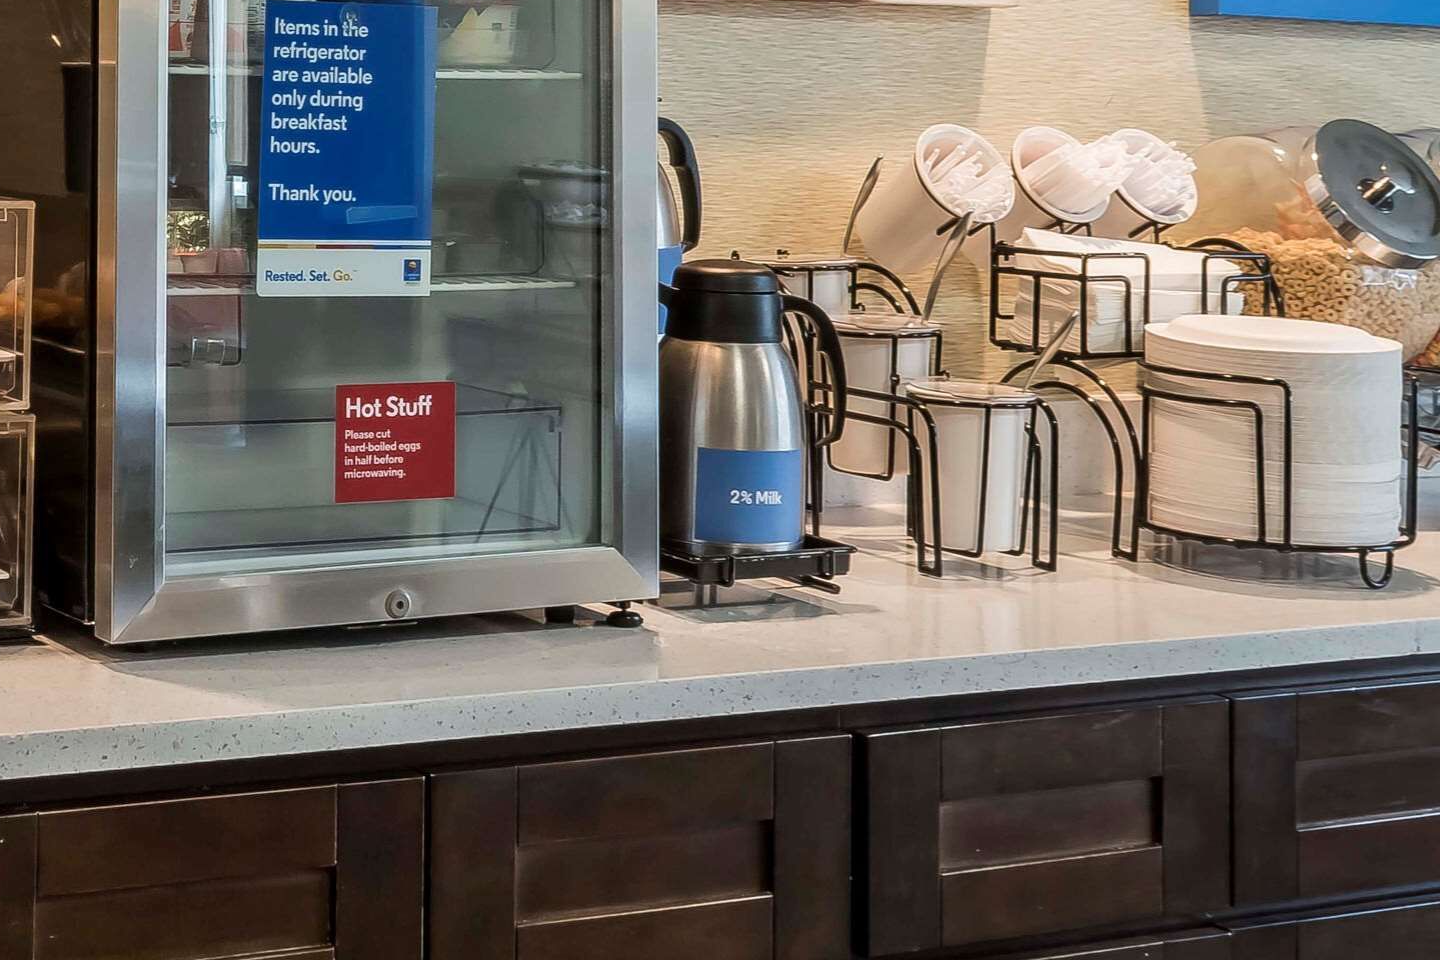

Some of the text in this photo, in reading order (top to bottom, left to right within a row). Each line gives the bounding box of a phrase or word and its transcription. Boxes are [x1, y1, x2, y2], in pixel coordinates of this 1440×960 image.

[274, 17, 320, 38] Items
[323, 19, 338, 38] in
[342, 20, 369, 39] the
[273, 43, 366, 63] refrigerator
[272, 66, 373, 85] are available
[271, 90, 363, 111] only during
[271, 113, 347, 132] breakfast
[270, 136, 320, 155] hours.
[268, 183, 357, 206] Thank you.
[265, 269, 306, 283] Rested.
[309, 269, 331, 283] Set.
[345, 394, 432, 418] Hot Stuff
[344, 429, 391, 440] Please cut
[344, 441, 421, 453] hard-boiled eggs
[344, 454, 404, 466] in half before
[344, 467, 406, 479] microwaving.
[729, 489, 783, 505] 2% Milk
